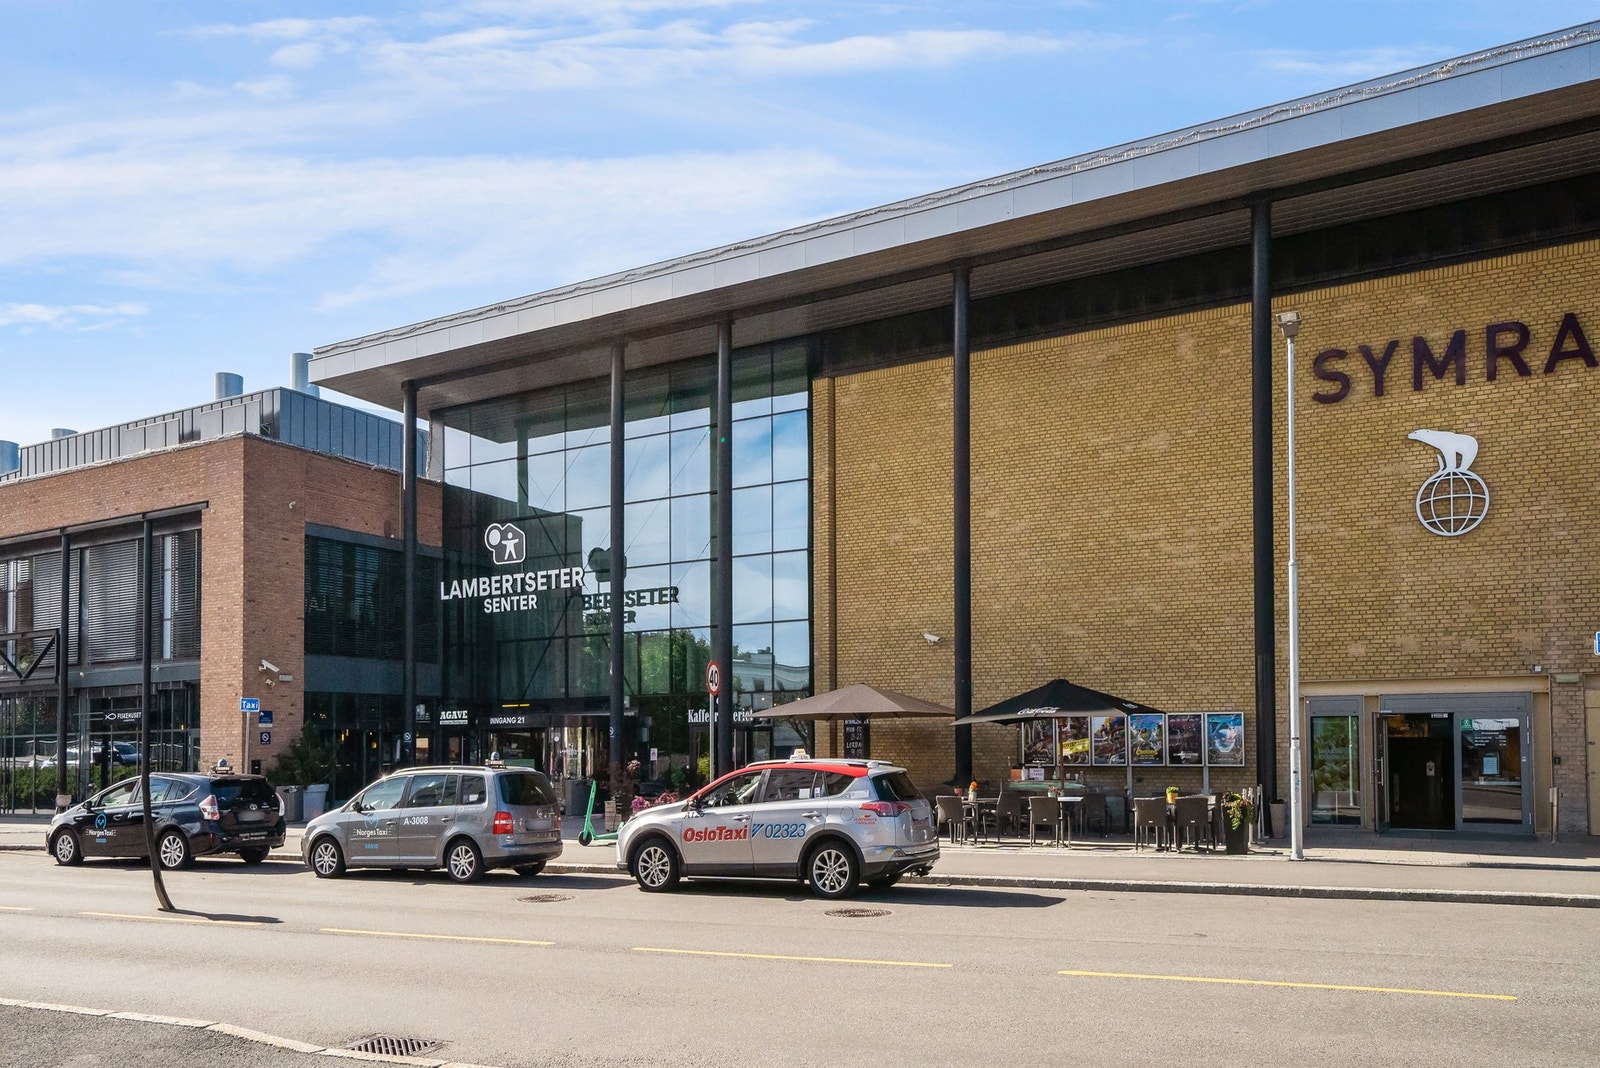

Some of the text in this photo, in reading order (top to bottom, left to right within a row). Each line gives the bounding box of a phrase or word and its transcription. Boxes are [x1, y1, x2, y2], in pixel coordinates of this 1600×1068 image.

[1312, 312, 1599, 404] SYMRA
[441, 567, 584, 600] LAMBERTSETER
[484, 595, 537, 613] SENTER
[709, 670, 718, 687] 40
[242, 701, 258, 709] Taxi
[117, 711, 142, 719] FISKEHUSET
[440, 710, 468, 720] AGAVE
[490, 717, 516, 725] INNGANG
[403, 816, 429, 826] A-3008
[683, 825, 748, 842] OsloTaxi
[764, 823, 807, 839] 02323
